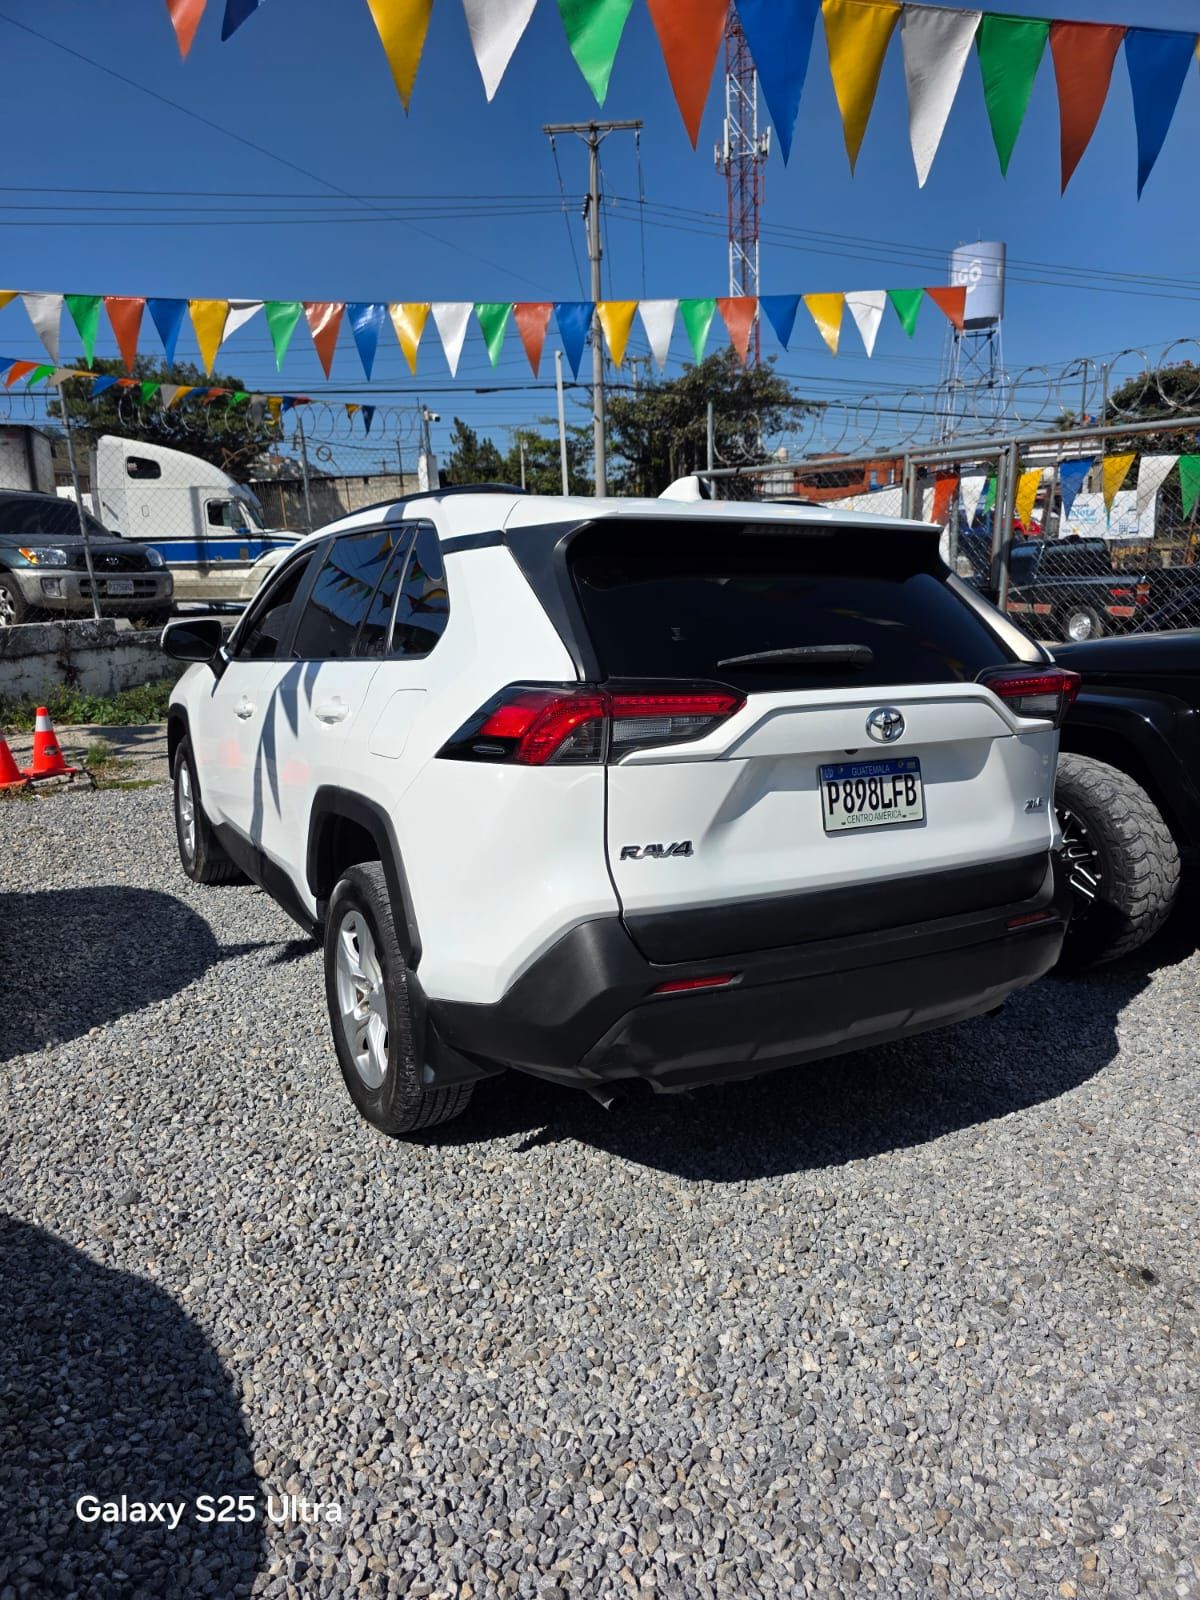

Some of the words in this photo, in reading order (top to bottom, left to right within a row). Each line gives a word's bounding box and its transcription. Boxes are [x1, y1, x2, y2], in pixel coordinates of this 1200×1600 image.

[851, 764, 891, 777] GUATEMALA
[826, 773, 917, 815] P898LFB
[846, 812, 874, 825] CENTRO
[619, 840, 694, 861] RAV4
